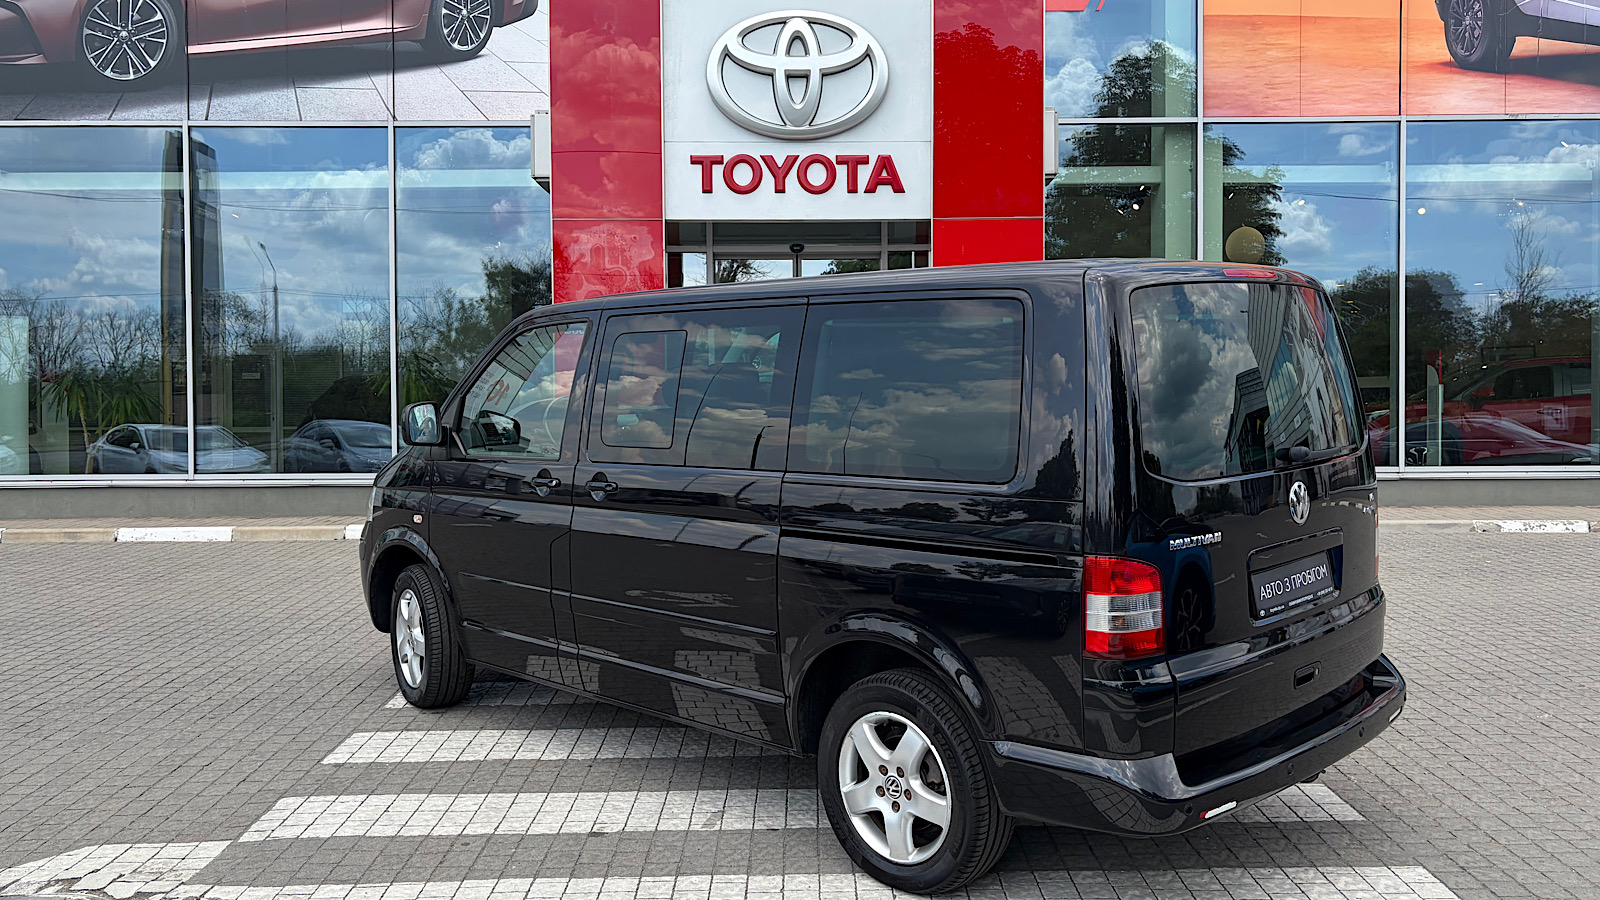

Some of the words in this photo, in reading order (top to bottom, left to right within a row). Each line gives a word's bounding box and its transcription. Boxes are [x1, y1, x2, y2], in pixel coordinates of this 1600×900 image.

[690, 154, 905, 195] TOYOTA
[1169, 531, 1222, 551] MULTIVAN
[1260, 580, 1284, 601] АВТО
[1291, 563, 1328, 590] ПРОБІГОМ
